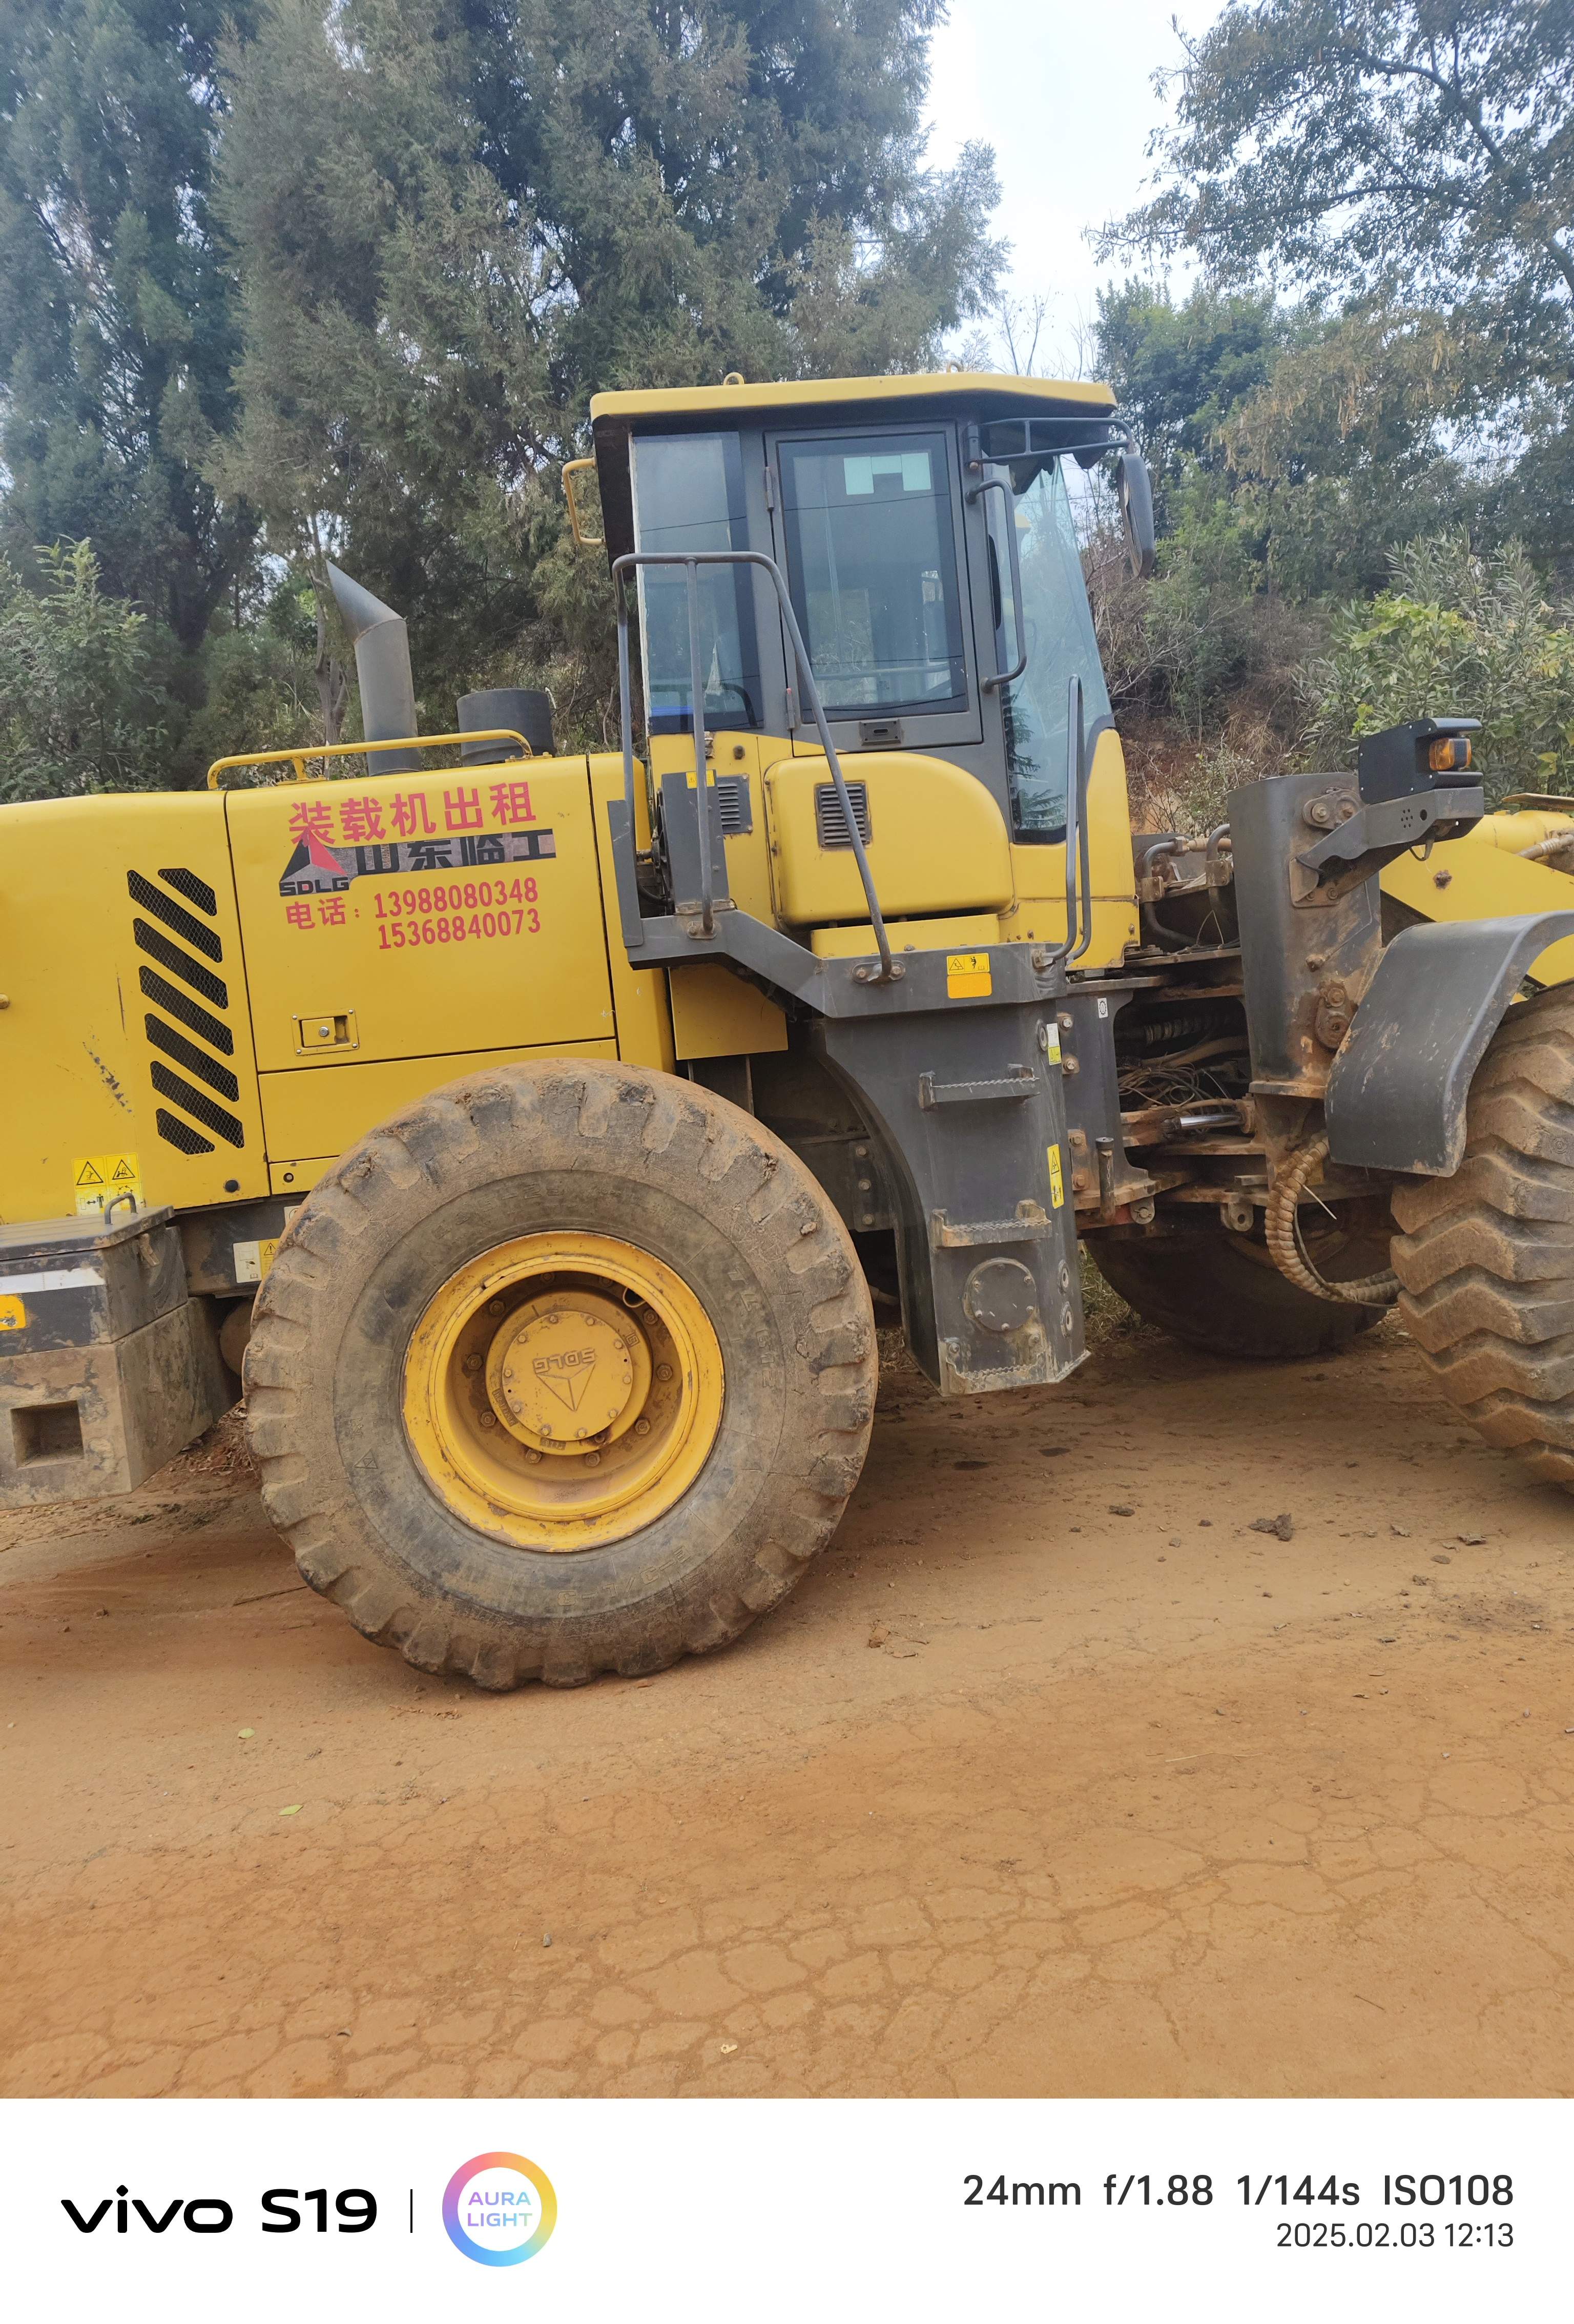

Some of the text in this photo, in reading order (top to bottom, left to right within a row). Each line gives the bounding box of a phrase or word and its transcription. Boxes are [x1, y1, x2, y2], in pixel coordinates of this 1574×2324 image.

[288, 781, 537, 846] 装载机出租
[355, 828, 556, 876] 山东临工
[279, 877, 349, 897] SDLG
[374, 877, 538, 918] 13988080348
[378, 908, 541, 949] 15368840073
[533, 1348, 597, 1374] SDLG
[557, 1545, 692, 1607] E-3/L-3
